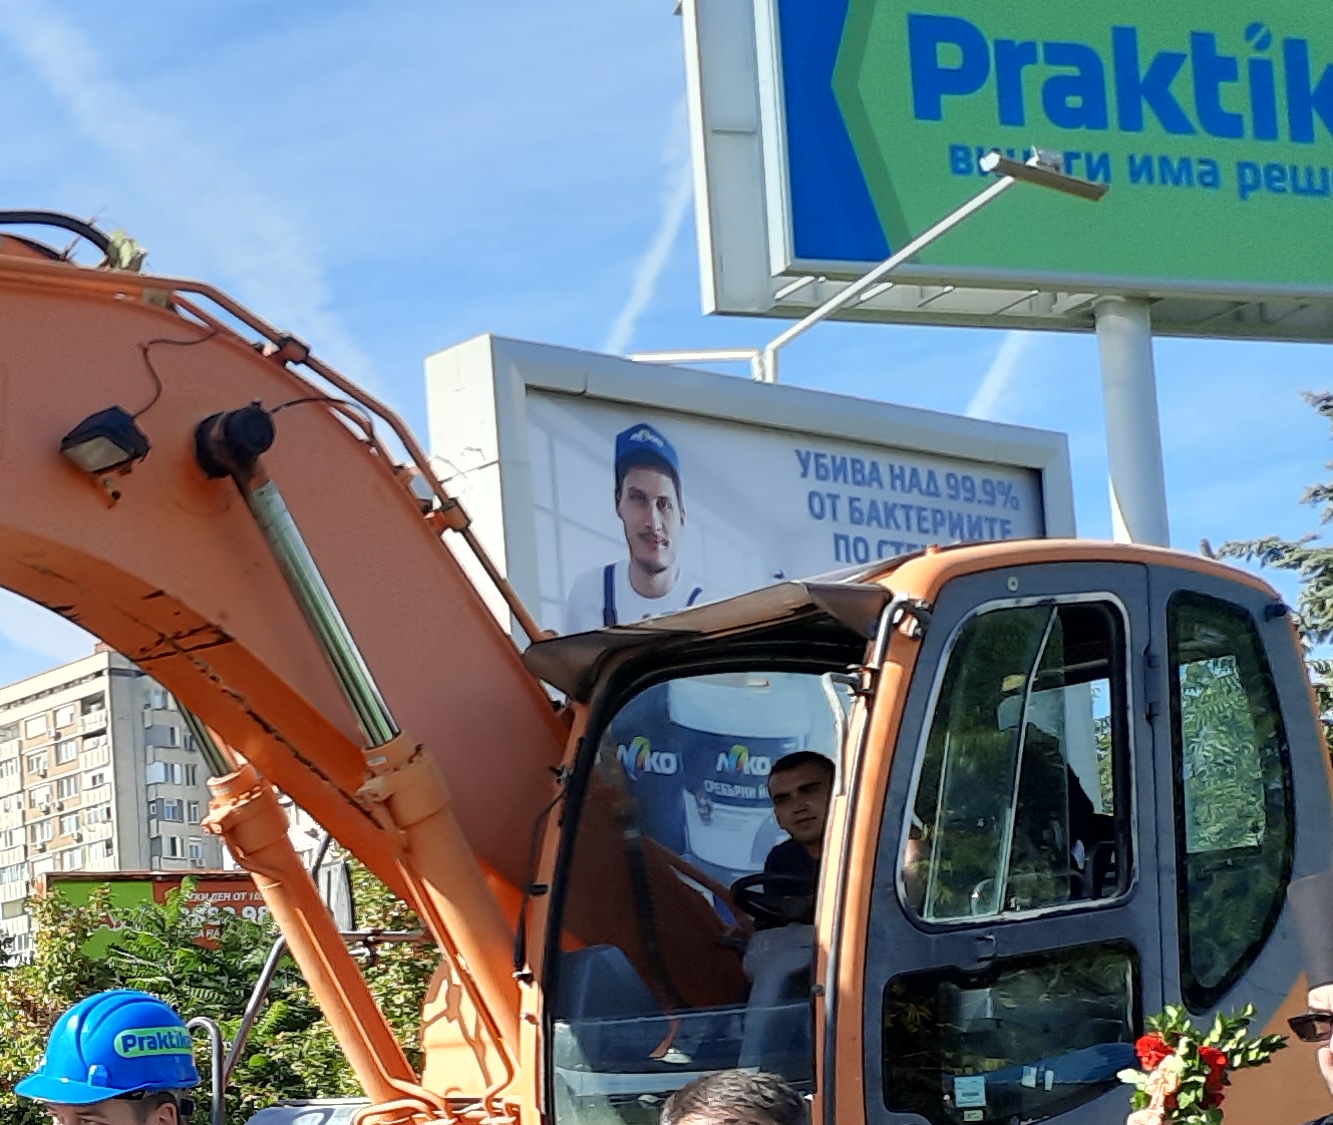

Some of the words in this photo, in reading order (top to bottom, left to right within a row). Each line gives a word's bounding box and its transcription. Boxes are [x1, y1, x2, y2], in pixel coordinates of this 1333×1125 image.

[1128, 154, 1220, 189] има
[1237, 160, 1332, 201] реш
[794, 449, 883, 490] УБИВА
[889, 463, 942, 499] НАД
[946, 472, 1020, 511] 99.9%
[808, 490, 842, 522] ОТ
[849, 496, 1013, 541] БАКТЕРИИТЕ
[833, 532, 870, 564] ПО
